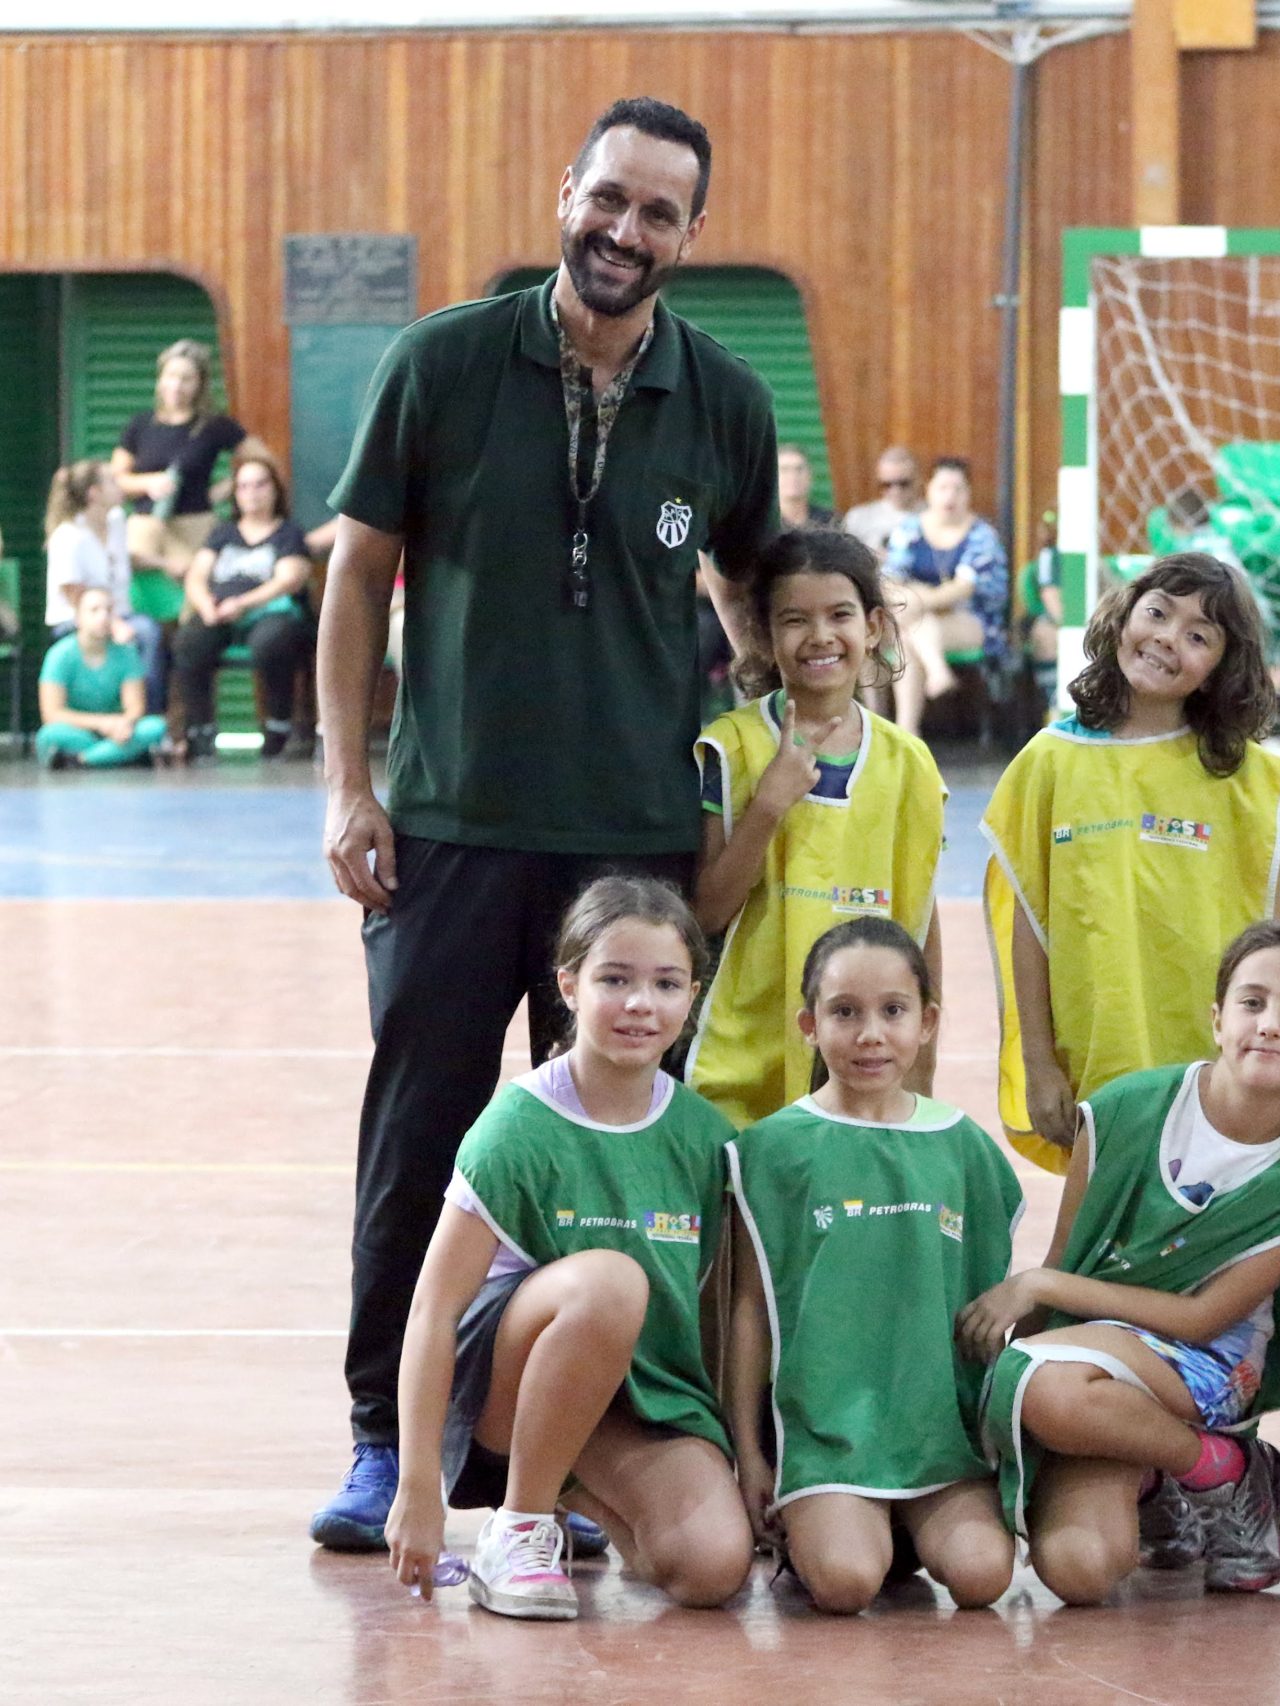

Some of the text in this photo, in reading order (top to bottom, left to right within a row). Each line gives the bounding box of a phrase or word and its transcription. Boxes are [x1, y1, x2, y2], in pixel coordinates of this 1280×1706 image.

[845, 1202, 932, 1217] BR PETROBRAS
[579, 1216, 638, 1230] PETROBRAS
